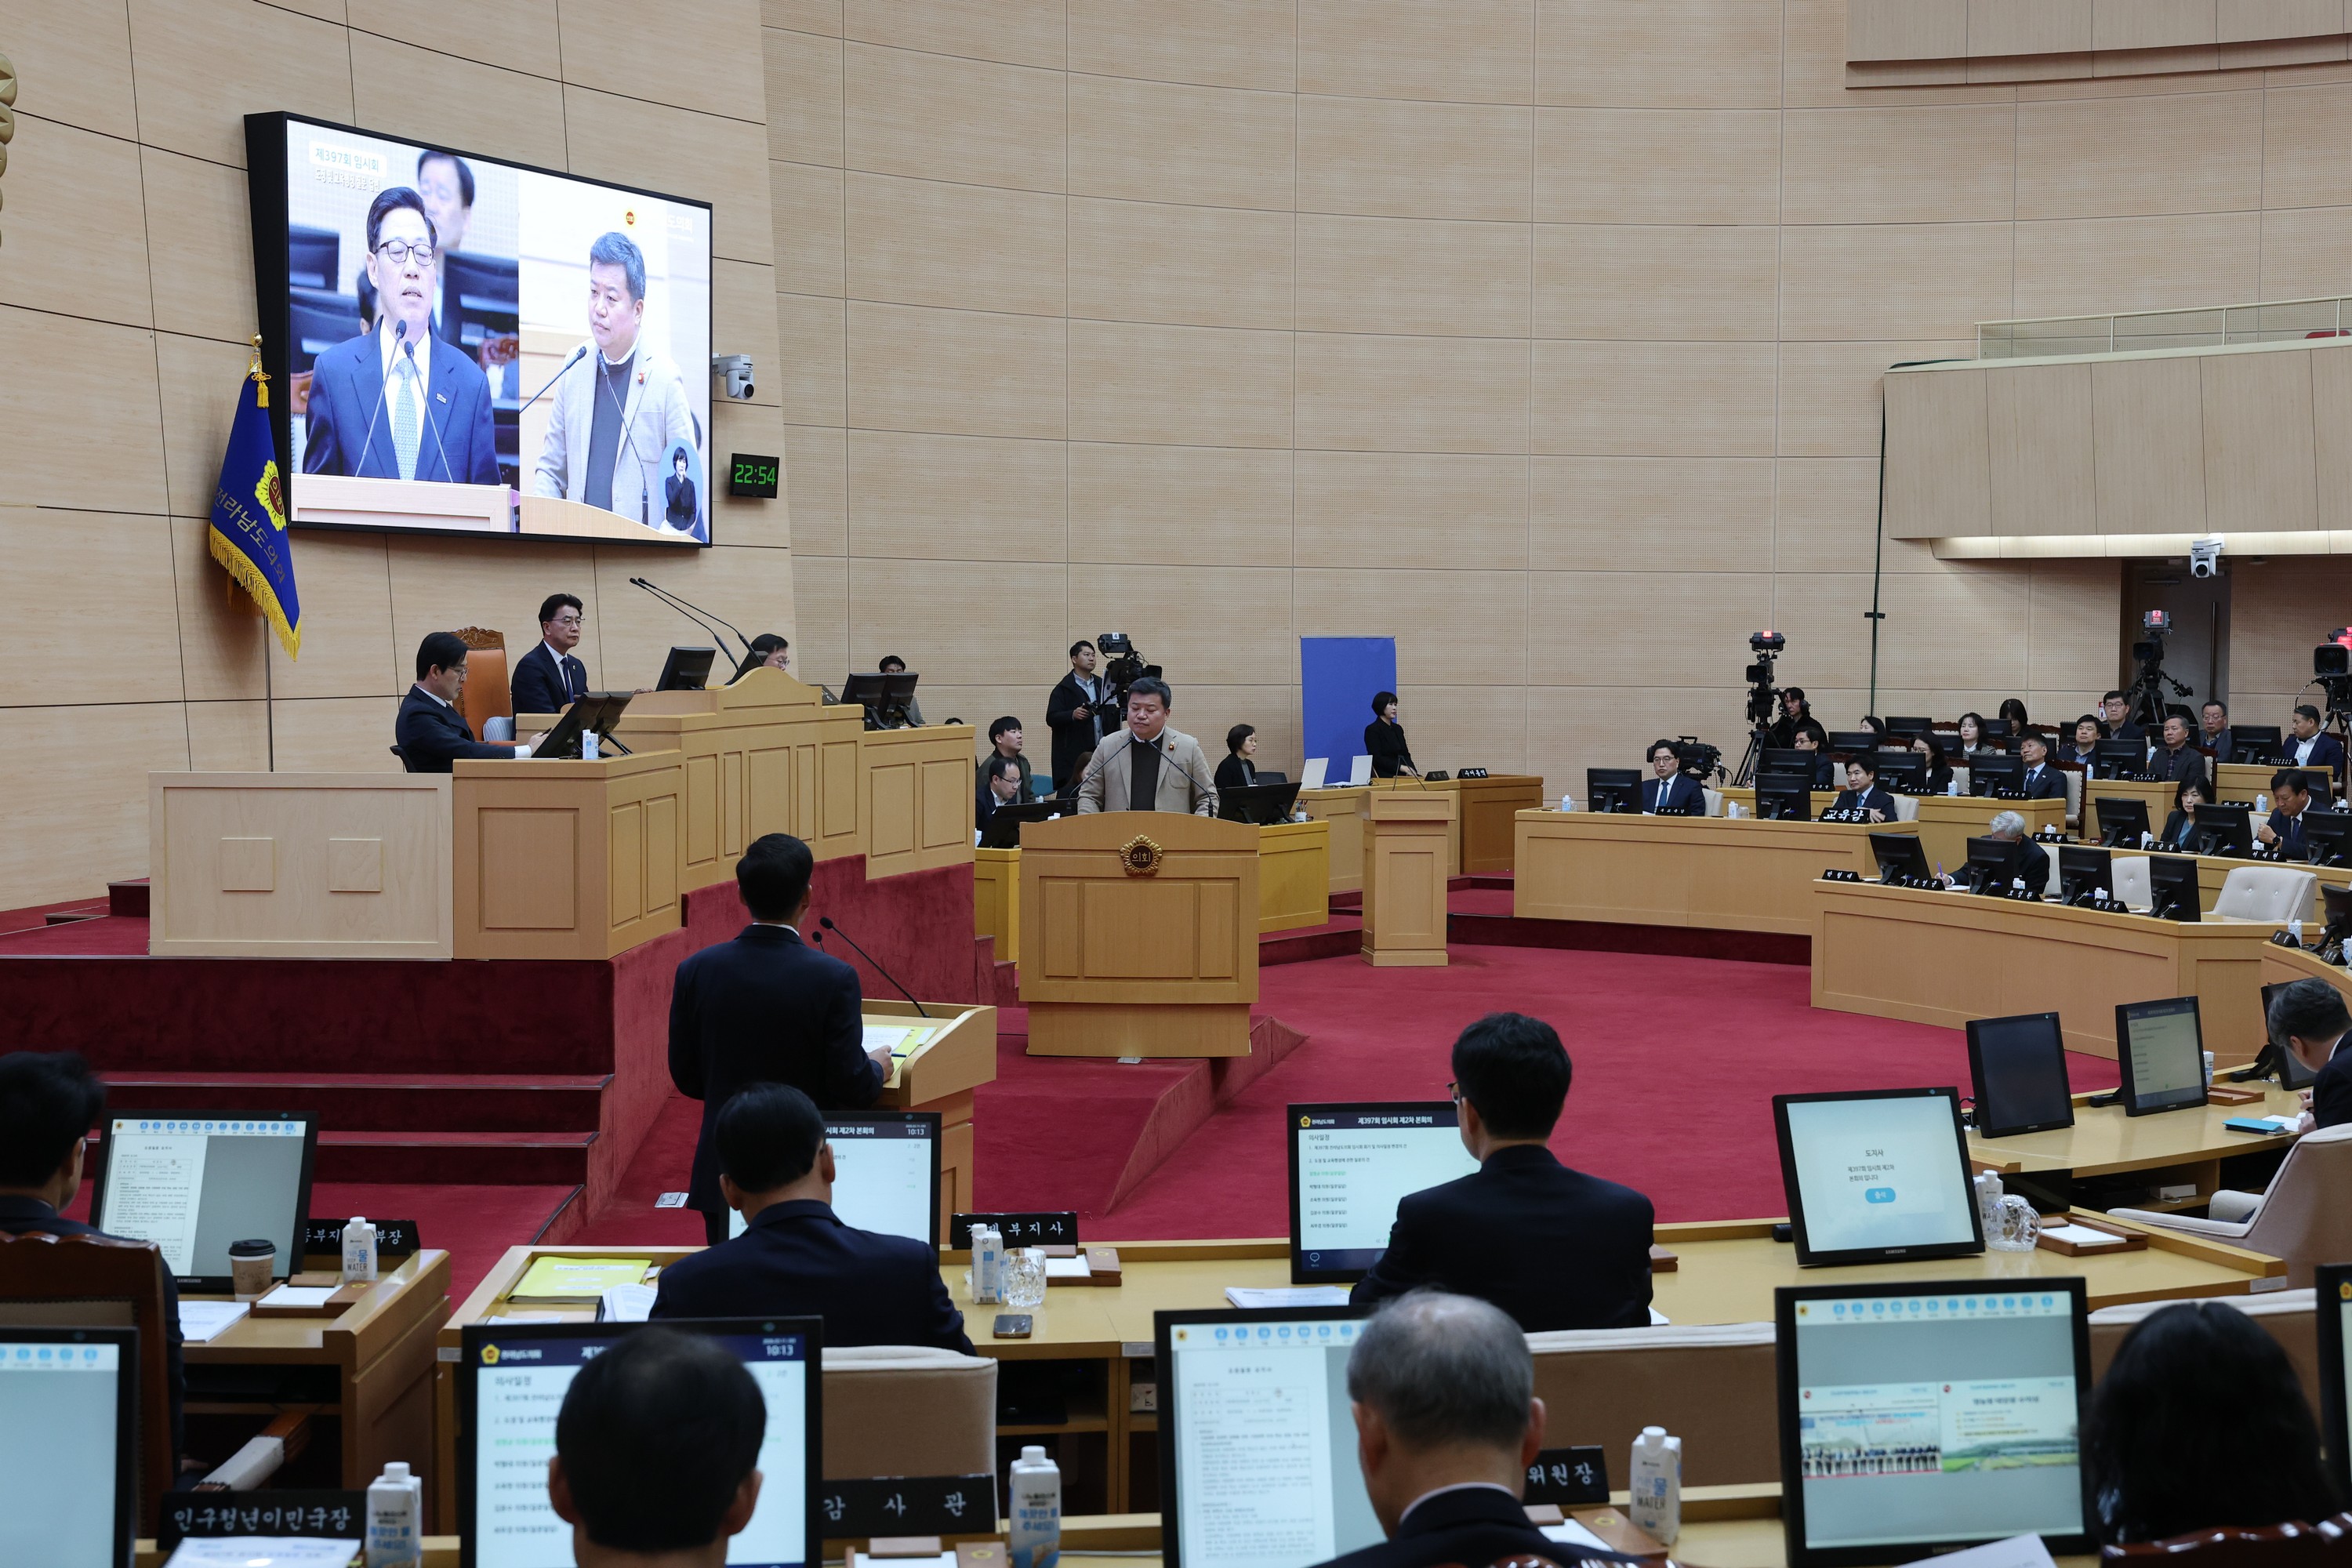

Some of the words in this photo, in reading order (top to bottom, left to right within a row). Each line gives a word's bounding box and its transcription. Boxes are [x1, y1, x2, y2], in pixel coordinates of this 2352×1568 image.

[315, 147, 351, 167] 제397회
[354, 155, 379, 173] 임시회
[735, 463, 776, 485] 22:54
[1823, 808, 1864, 822] 교육감
[1131, 851, 1151, 862] 의회
[839, 1127, 855, 1135] 제2차
[856, 1127, 875, 1135] 본회의
[1865, 1149, 1884, 1157] 도지사
[966, 1221, 1064, 1236] 제부지사
[347, 1263, 368, 1272] WATER
[1528, 1461, 1594, 1486] 위원장
[824, 1491, 967, 1521] 감사관
[174, 1507, 351, 1531] 인구청년이민국장
